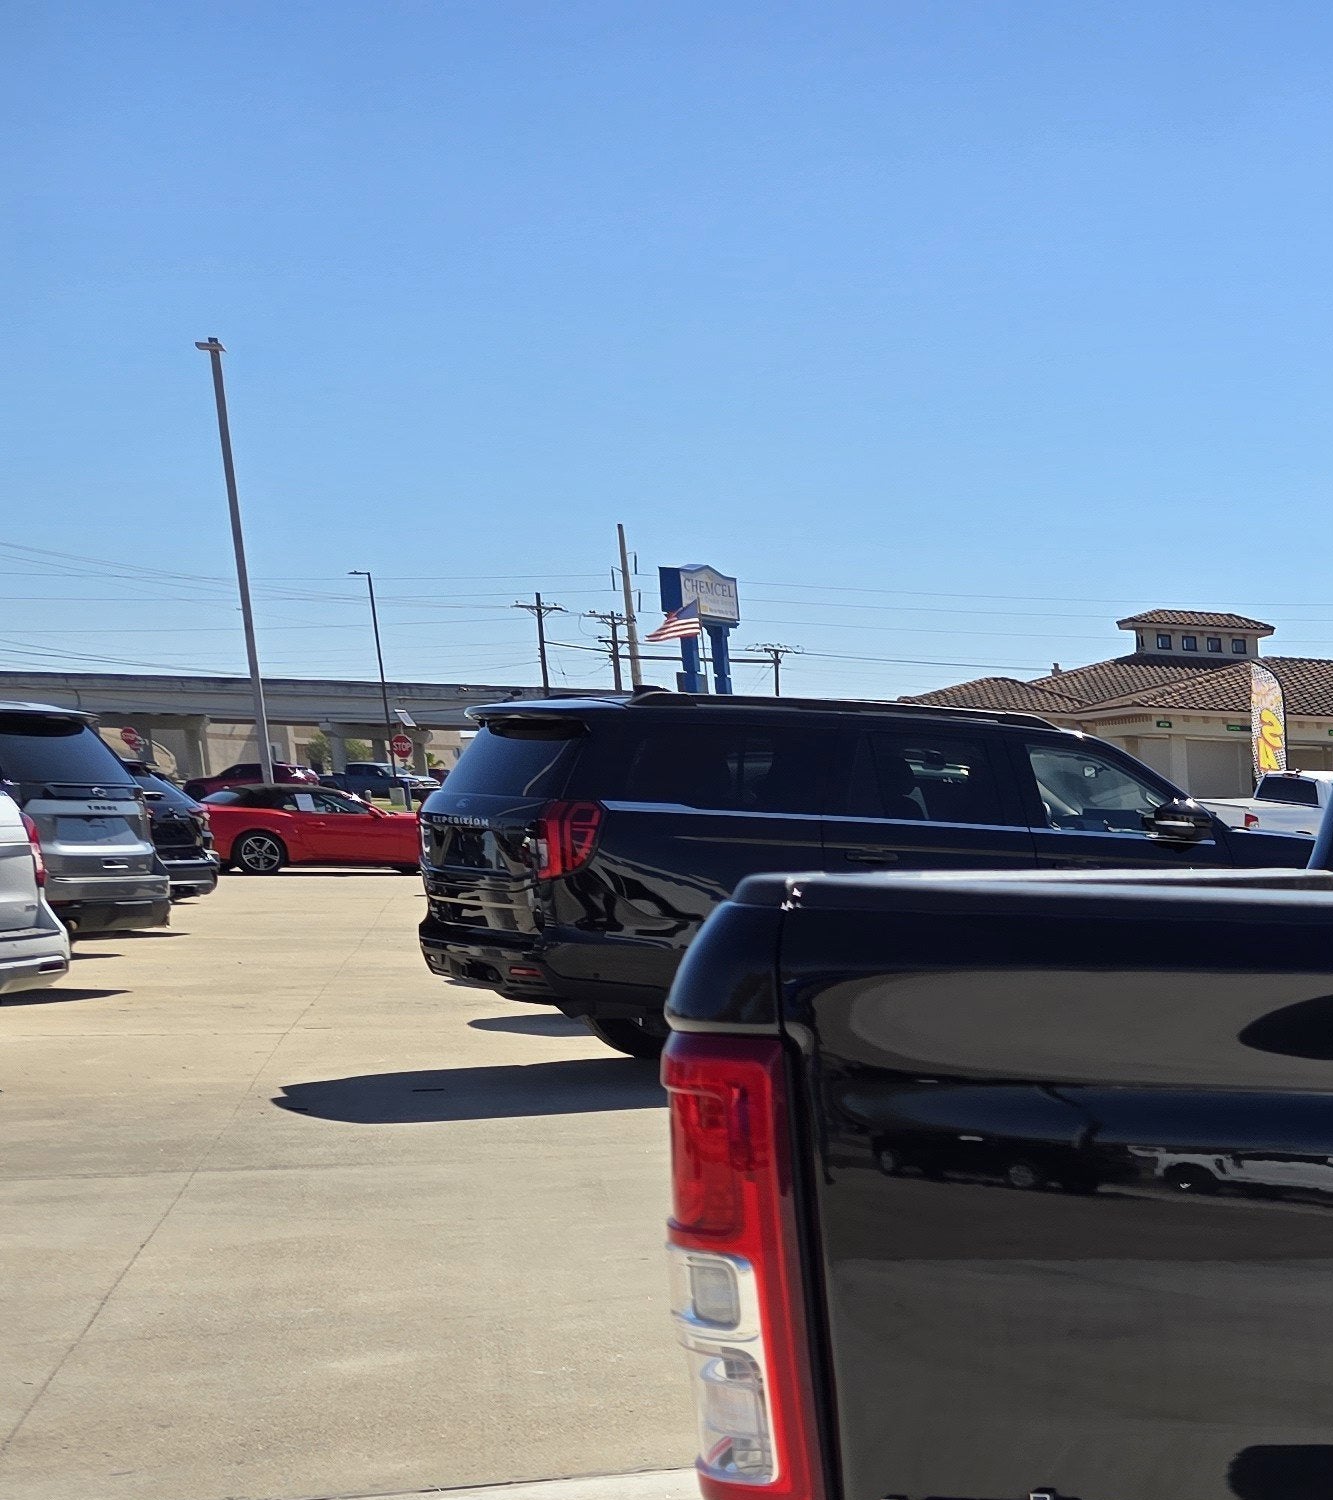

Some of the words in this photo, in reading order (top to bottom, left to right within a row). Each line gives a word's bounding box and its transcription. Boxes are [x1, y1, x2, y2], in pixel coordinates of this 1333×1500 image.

[683, 579, 734, 598] CHEMCEL
[393, 741, 412, 751] STOP
[432, 814, 489, 827] EXPEDITION
